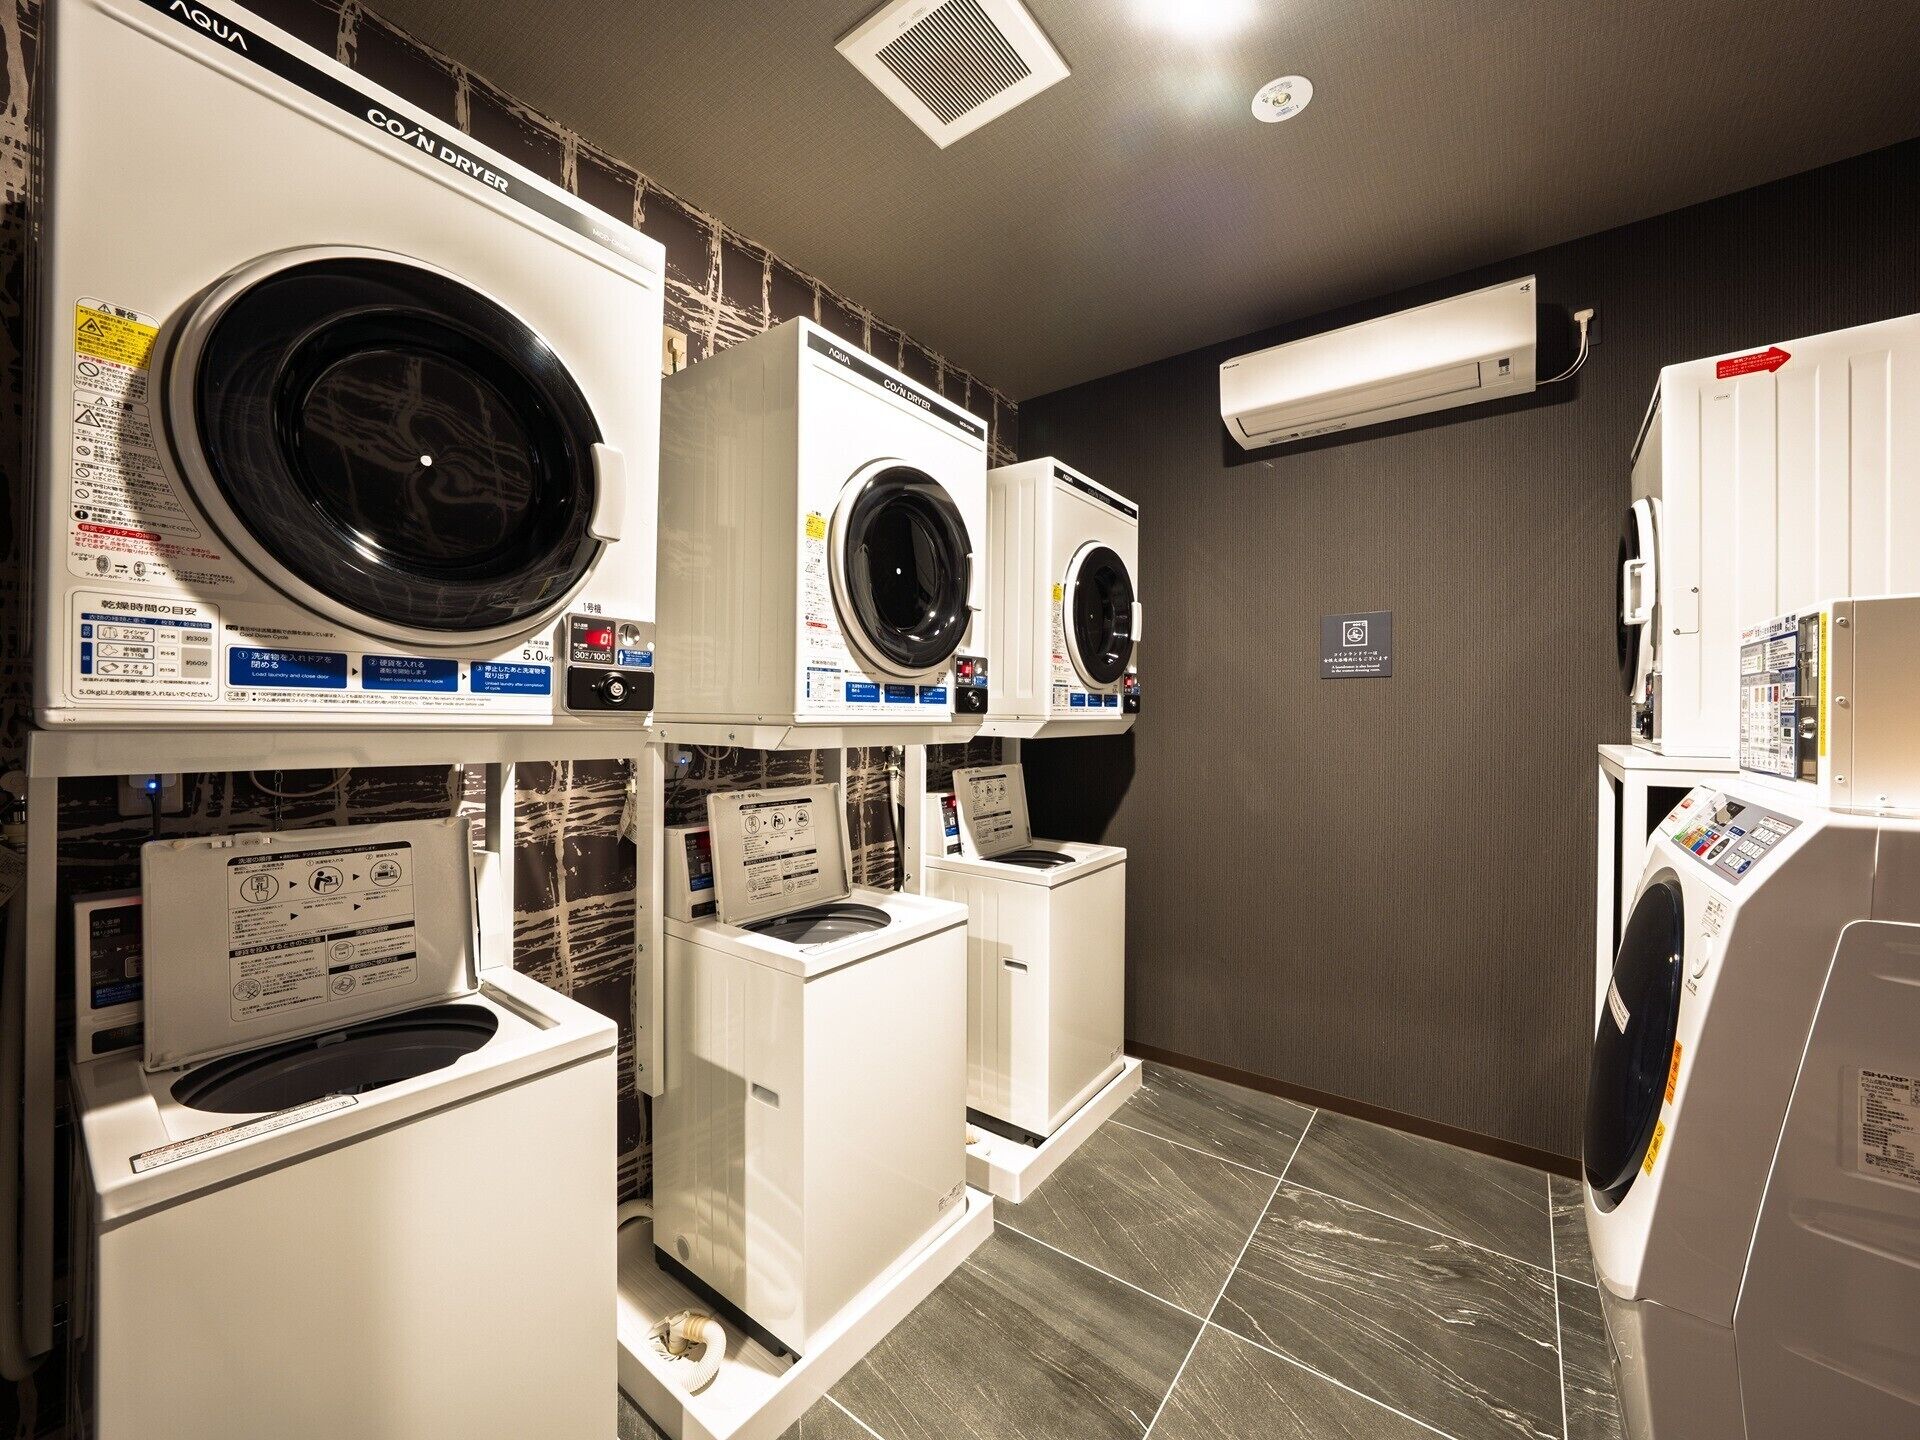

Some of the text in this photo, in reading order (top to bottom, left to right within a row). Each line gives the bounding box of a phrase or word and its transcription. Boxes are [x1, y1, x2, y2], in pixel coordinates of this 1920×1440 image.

[169, 0, 248, 51] AQUA
[367, 108, 509, 194] COIN DRYER
[115, 307, 138, 322] 警告
[828, 346, 851, 366] AQUA
[883, 379, 932, 411] COIN DRYER
[111, 399, 134, 412] 注意
[101, 599, 197, 616] 乾燥時間の目安
[583, 602, 602, 614] 1号機
[251, 652, 333, 664] 洗濯物を入れドアを
[379, 659, 425, 669] 硬貨を入れる
[250, 660, 279, 670] 閉める
[484, 665, 546, 675] 停止したあと洗濯物を
[484, 672, 511, 680] 取り出す
[1862, 1070, 1909, 1083] SHARP
